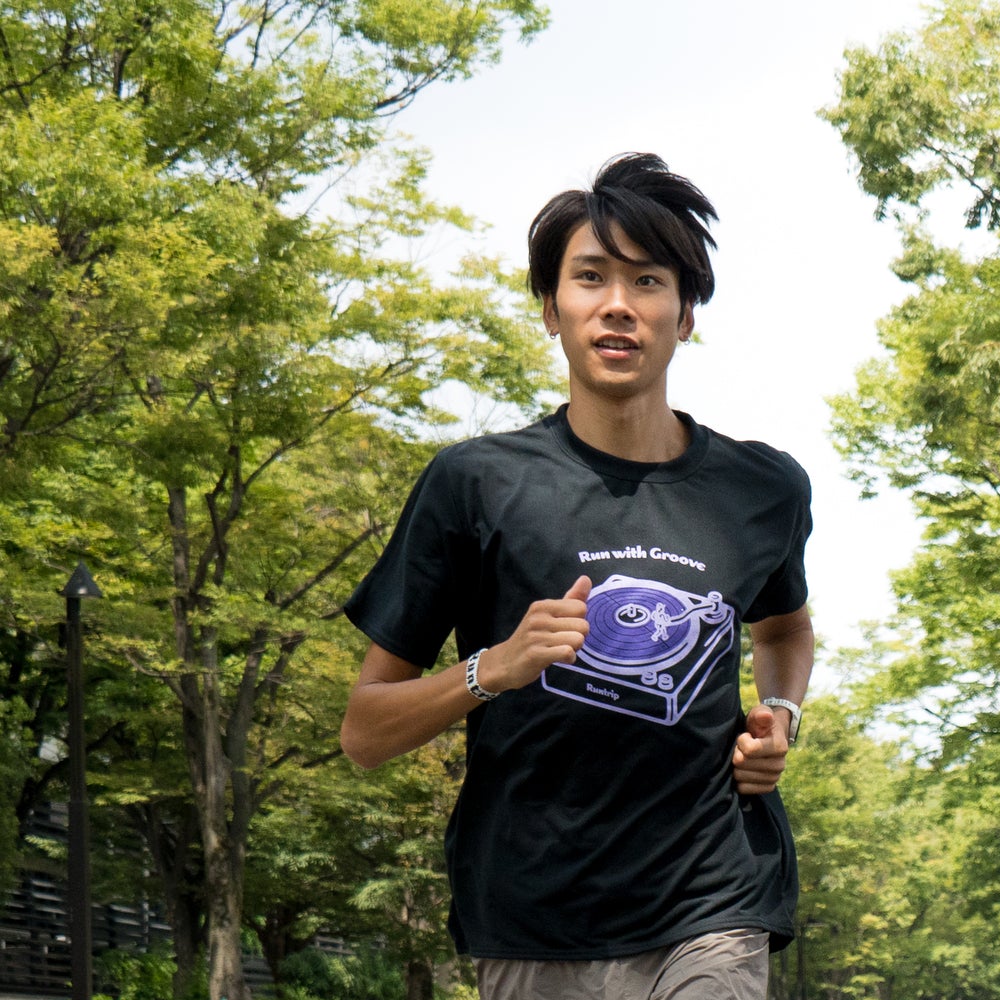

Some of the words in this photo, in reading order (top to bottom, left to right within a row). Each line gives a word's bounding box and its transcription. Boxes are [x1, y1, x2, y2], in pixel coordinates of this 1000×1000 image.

[578, 550, 611, 563] Run
[611, 545, 647, 559] with
[649, 547, 706, 571] Groove
[586, 682, 620, 701] Runtrip
